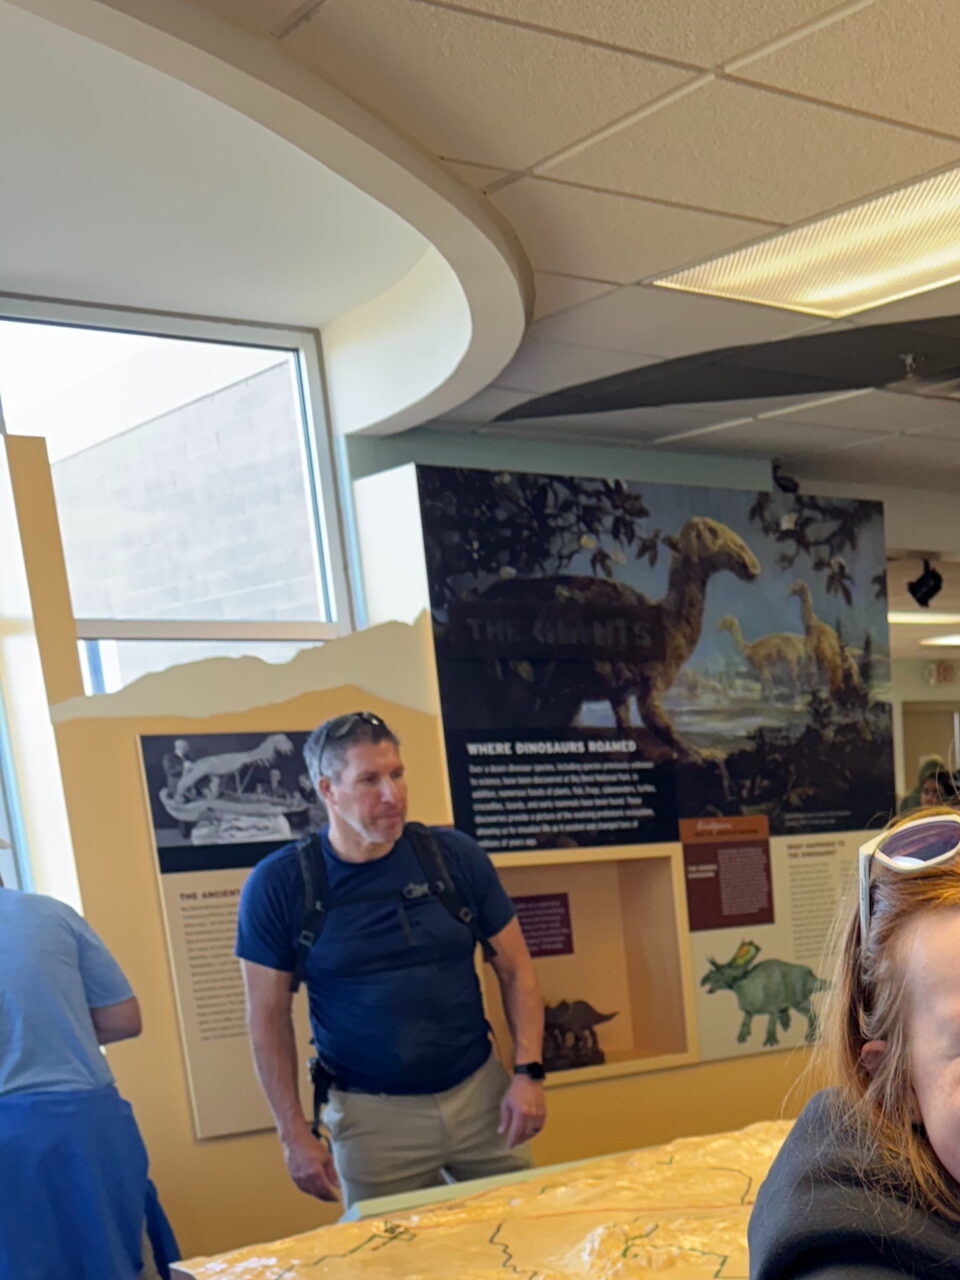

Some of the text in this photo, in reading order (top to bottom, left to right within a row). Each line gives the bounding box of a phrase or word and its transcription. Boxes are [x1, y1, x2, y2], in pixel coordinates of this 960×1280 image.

[466, 739, 637, 756] WHERE DINOSAURS ROAMED
[179, 889, 241, 900] THE ANCIENT
